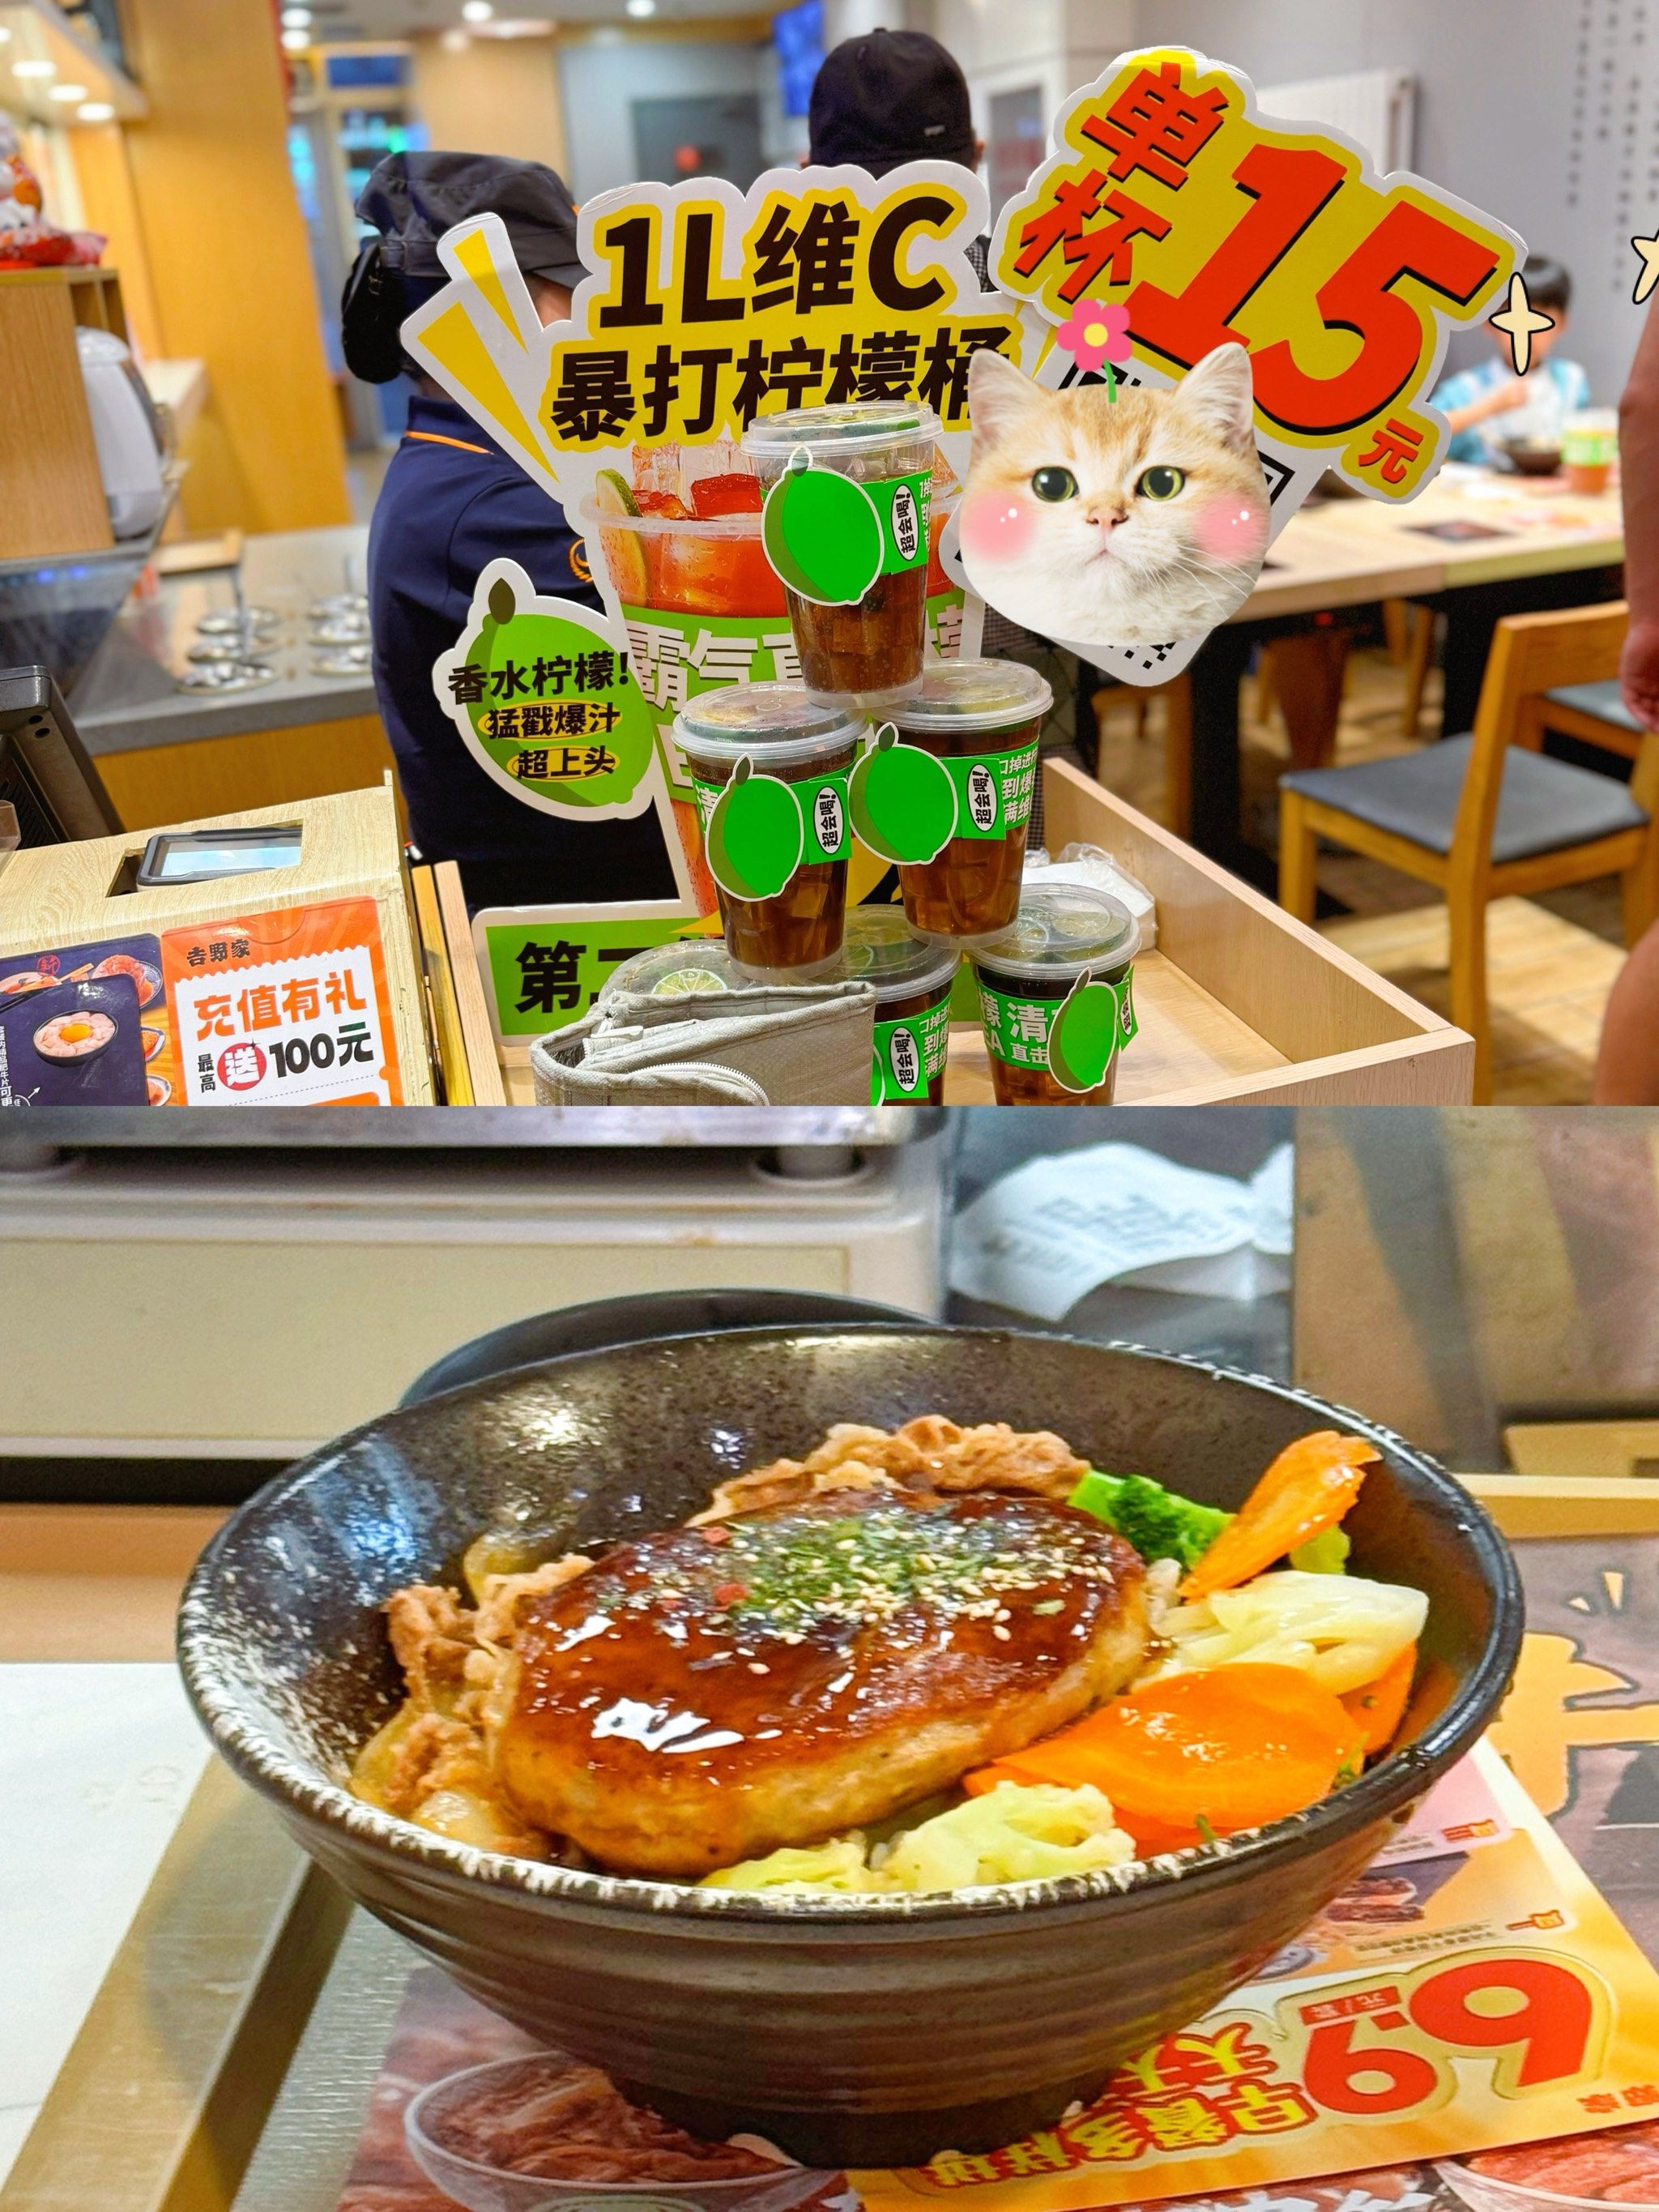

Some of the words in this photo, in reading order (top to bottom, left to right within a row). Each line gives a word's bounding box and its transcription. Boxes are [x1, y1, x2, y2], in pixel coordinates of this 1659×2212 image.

[1014, 62, 1229, 303] 单杯
[599, 195, 957, 329] 1L维C
[448, 651, 629, 705] 香水柠檬!
[487, 702, 621, 740] 猛戳爆汁
[516, 745, 616, 780] 超上头
[194, 968, 368, 1043] 充值有礼
[198, 1053, 216, 1094] 最高
[224, 1046, 260, 1087] 送
[269, 1021, 375, 1079] 100元
[1303, 1959, 1593, 2116] 6.9
